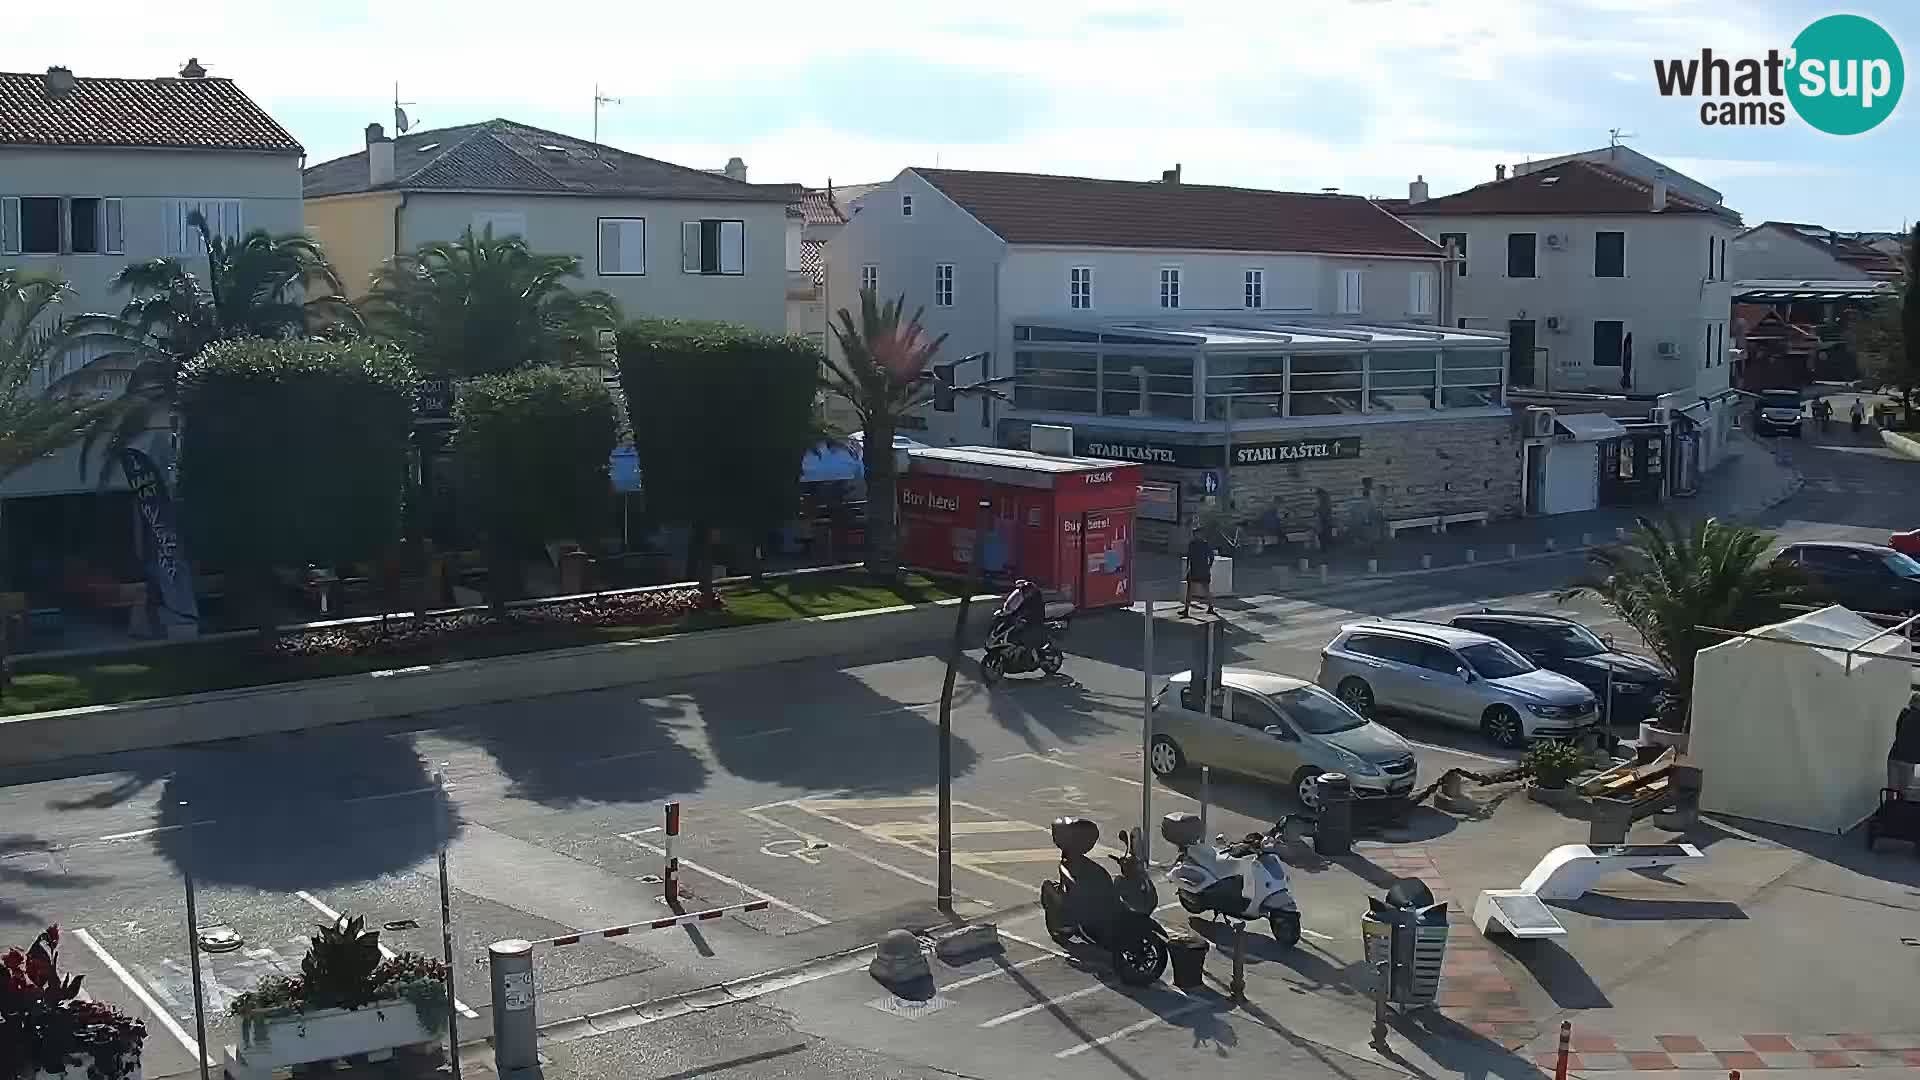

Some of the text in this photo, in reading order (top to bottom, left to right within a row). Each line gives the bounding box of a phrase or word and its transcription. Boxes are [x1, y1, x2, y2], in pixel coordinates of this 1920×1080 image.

[1088, 443, 1124, 458] STARI
[1237, 441, 1329, 462] STARI KAŠTEL
[1085, 472, 1113, 484] TISAK
[903, 488, 960, 512] Buy here!
[1064, 519, 1082, 534] Buy
